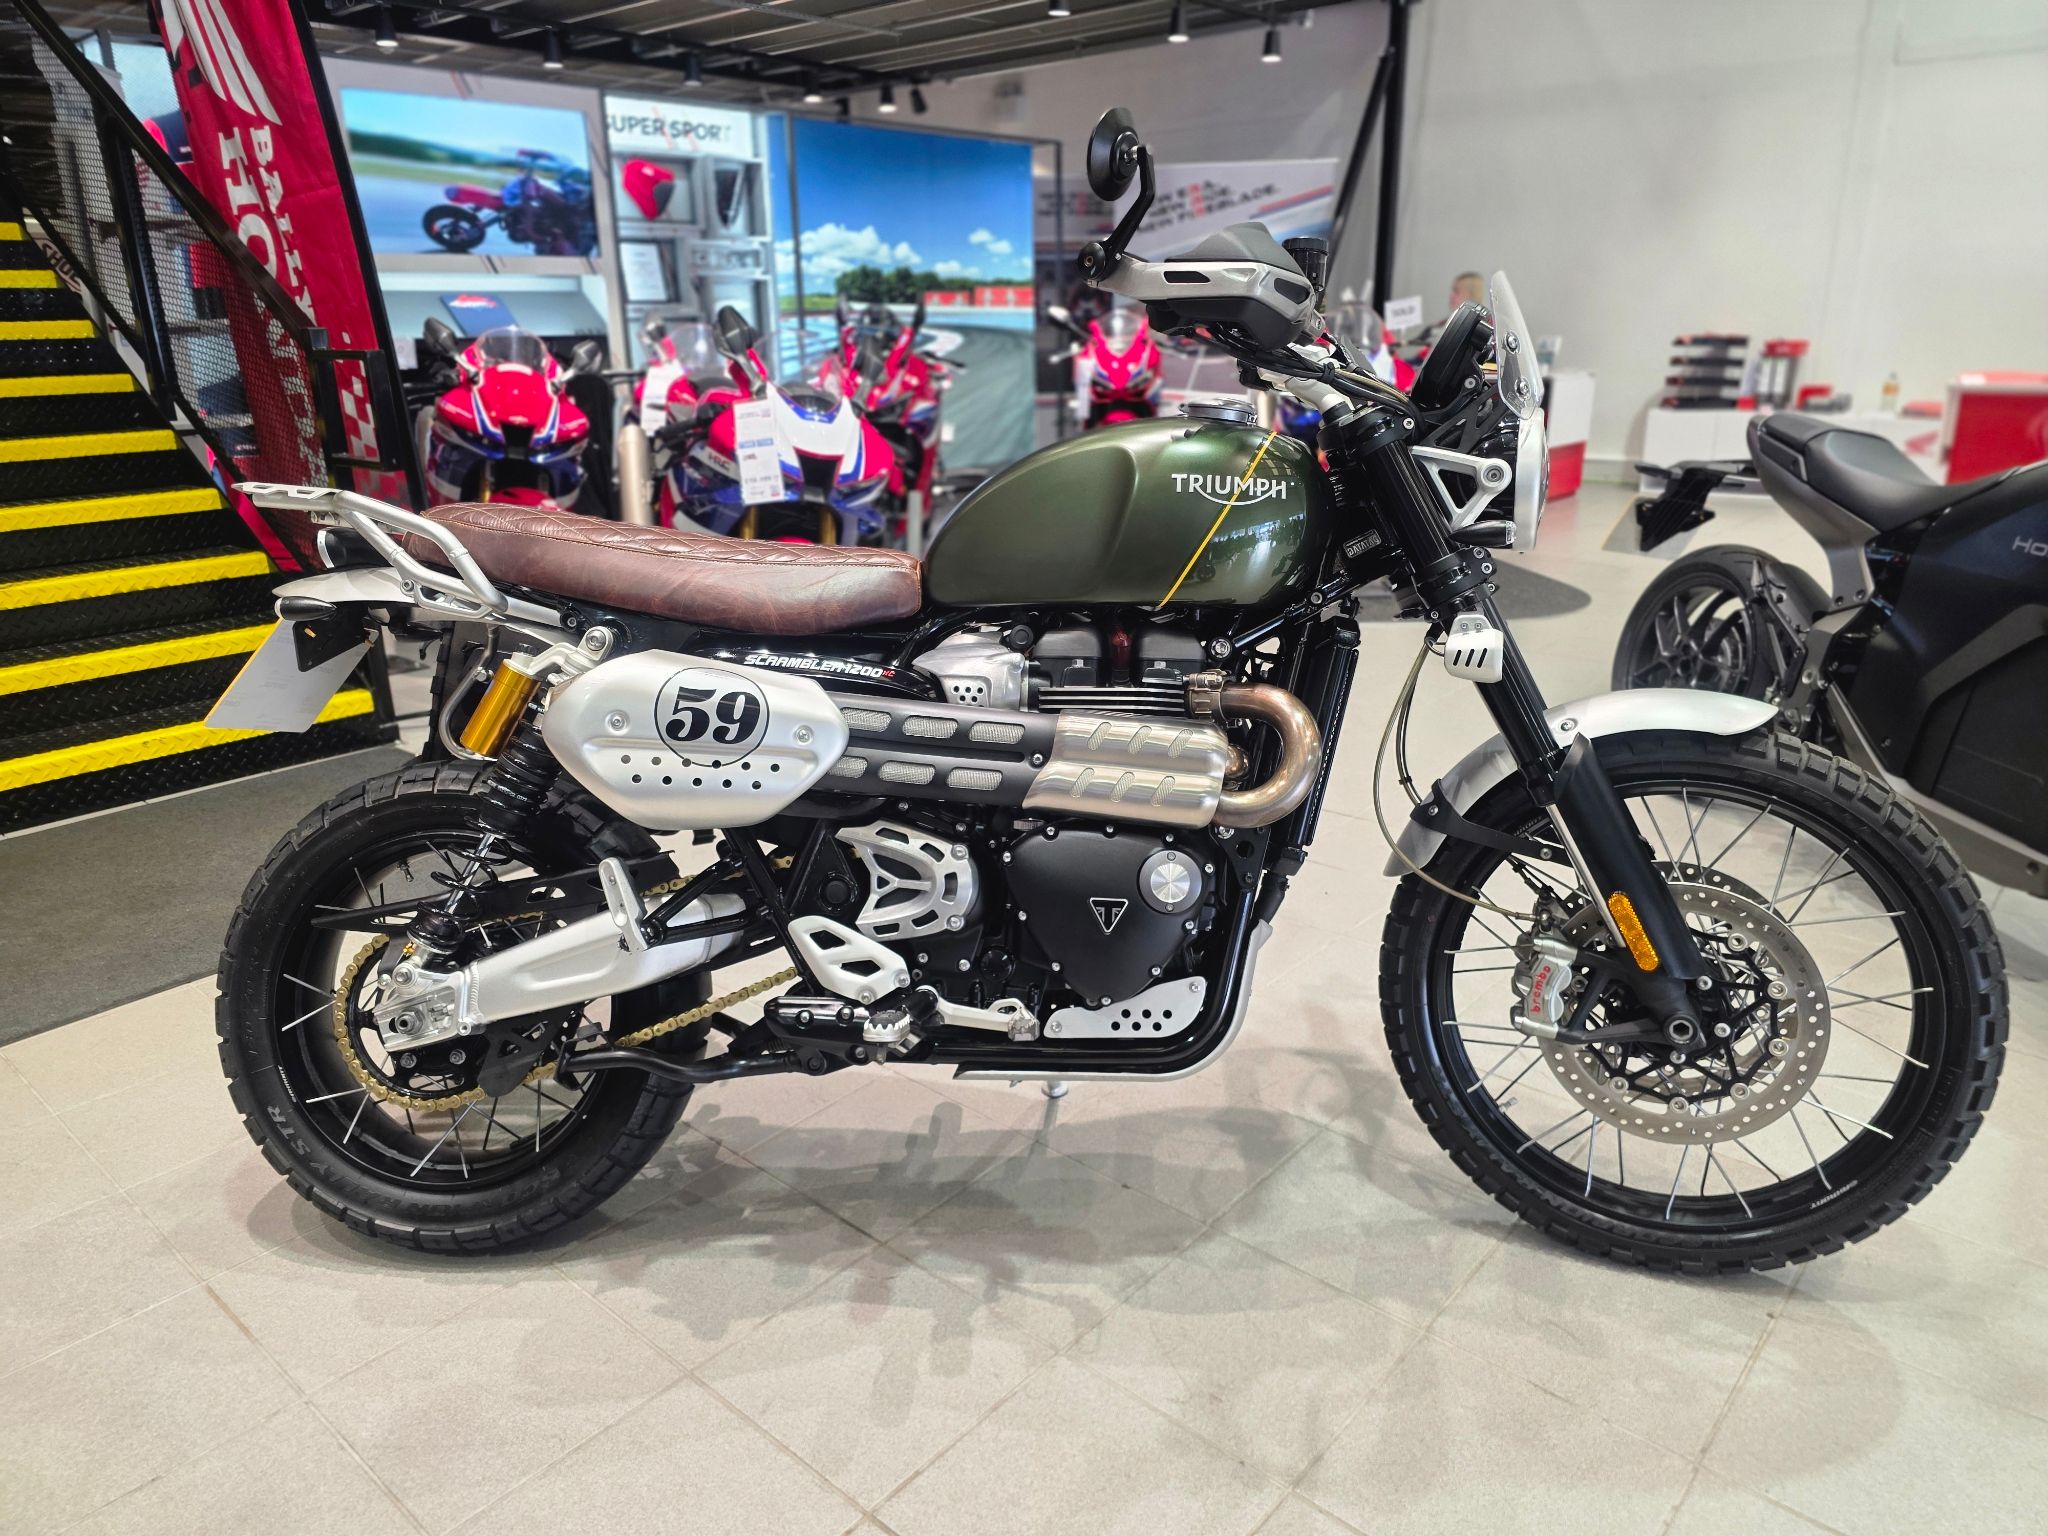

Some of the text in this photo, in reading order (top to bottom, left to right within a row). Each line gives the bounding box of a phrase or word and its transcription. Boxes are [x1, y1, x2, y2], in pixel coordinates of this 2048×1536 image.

[1171, 473, 1287, 506] TRIUMPH
[665, 686, 761, 745] 59
[1530, 965, 1551, 1013] brembo
